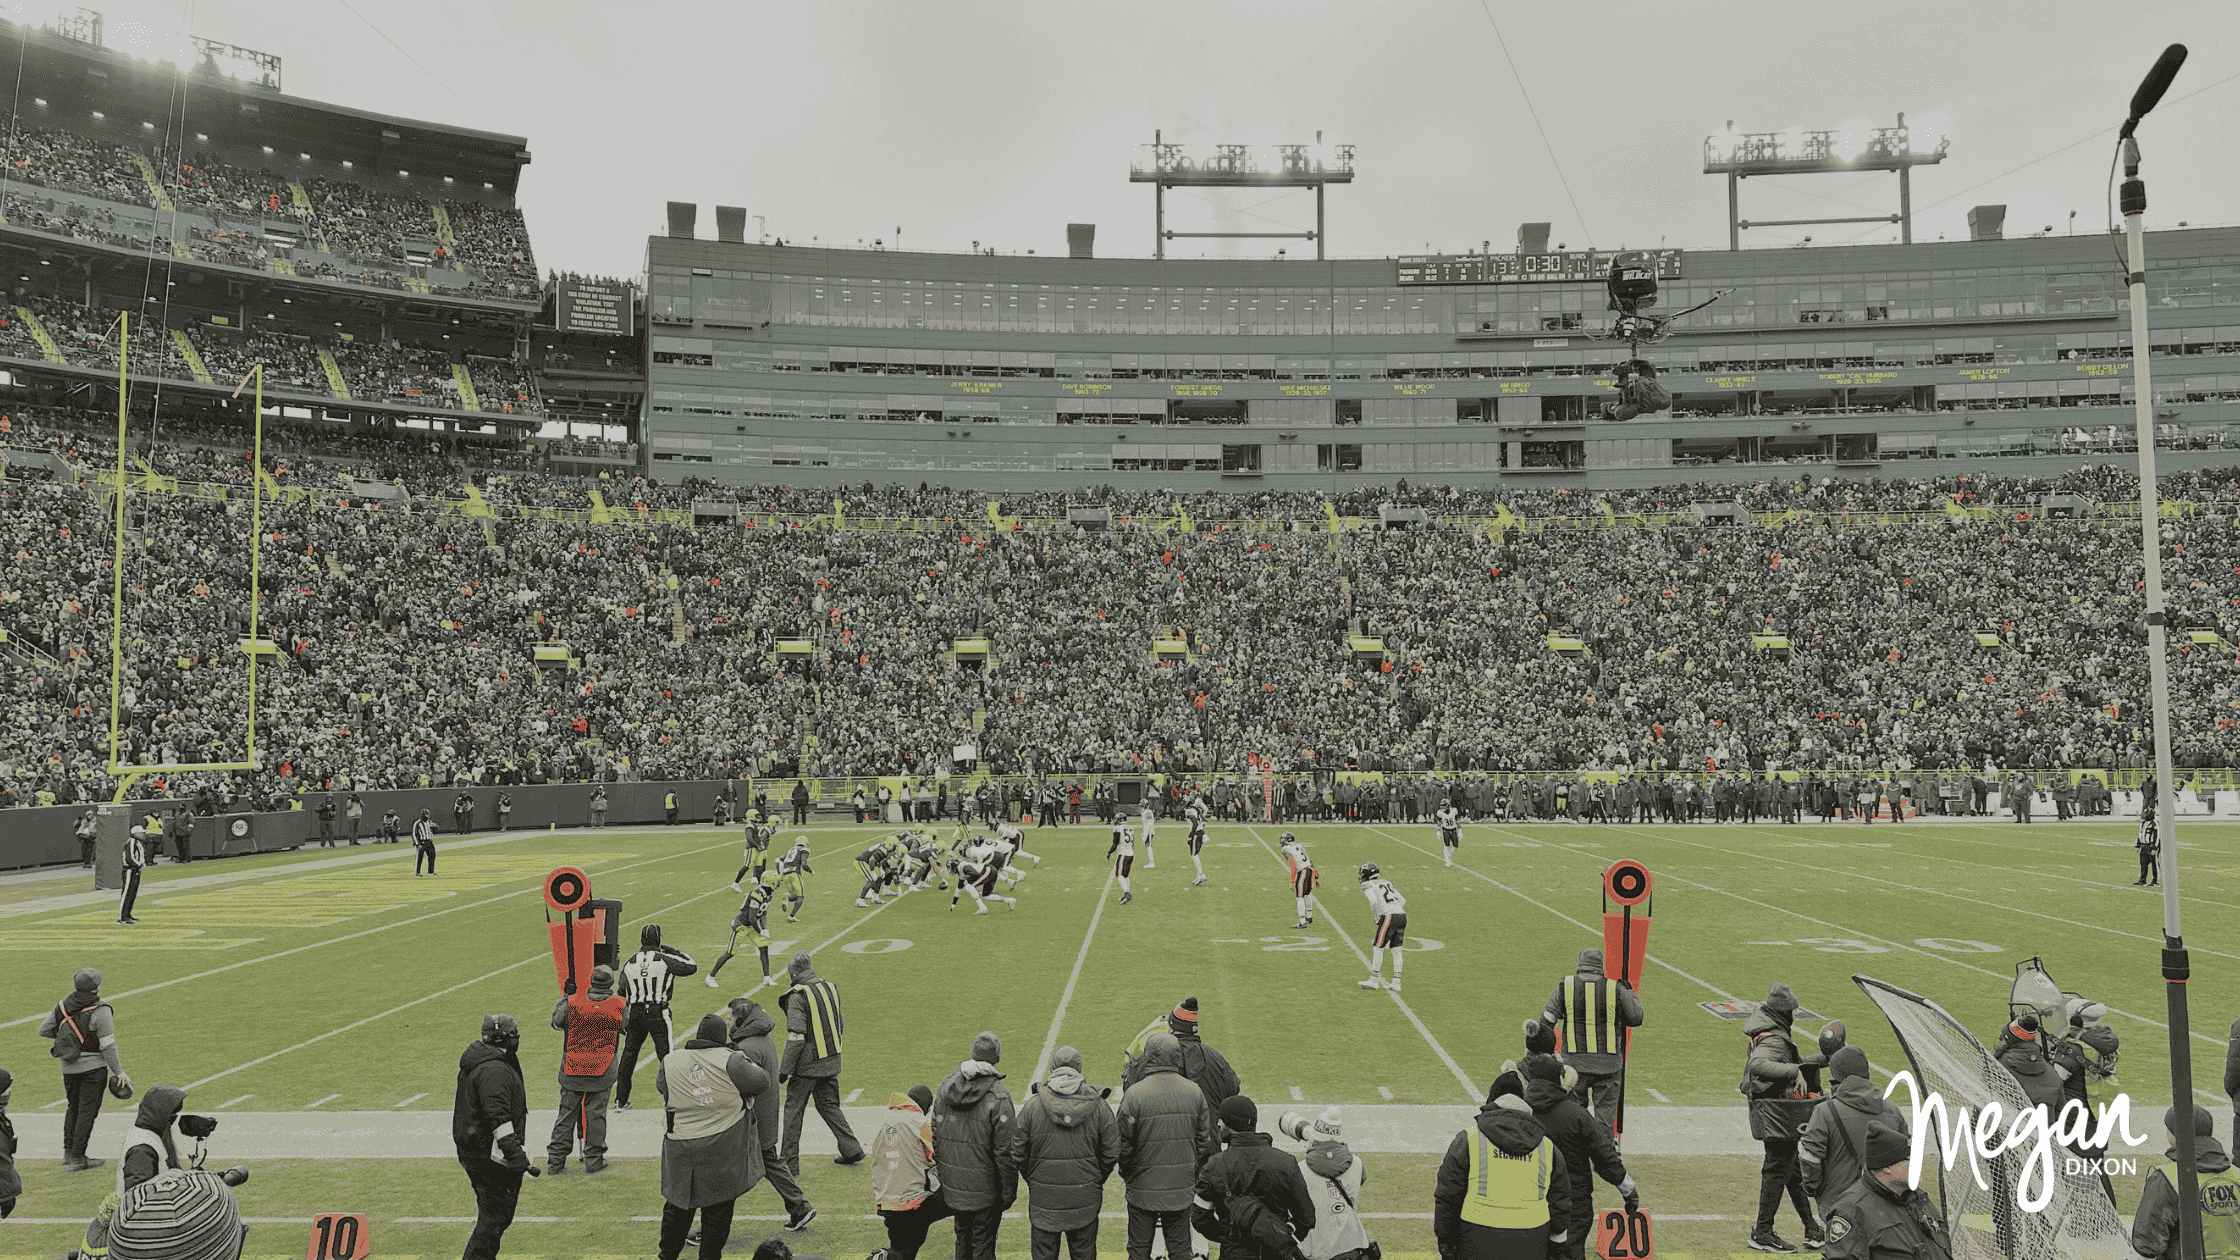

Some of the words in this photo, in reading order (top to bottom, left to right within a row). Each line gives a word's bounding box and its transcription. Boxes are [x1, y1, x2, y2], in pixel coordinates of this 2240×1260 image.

[1526, 256, 1560, 272] 0:30
[2076, 364, 2102, 372] BOBBY
[2208, 1185, 2238, 1203] FOX
[316, 1216, 358, 1260] 10
[1605, 1211, 1650, 1258] 20
